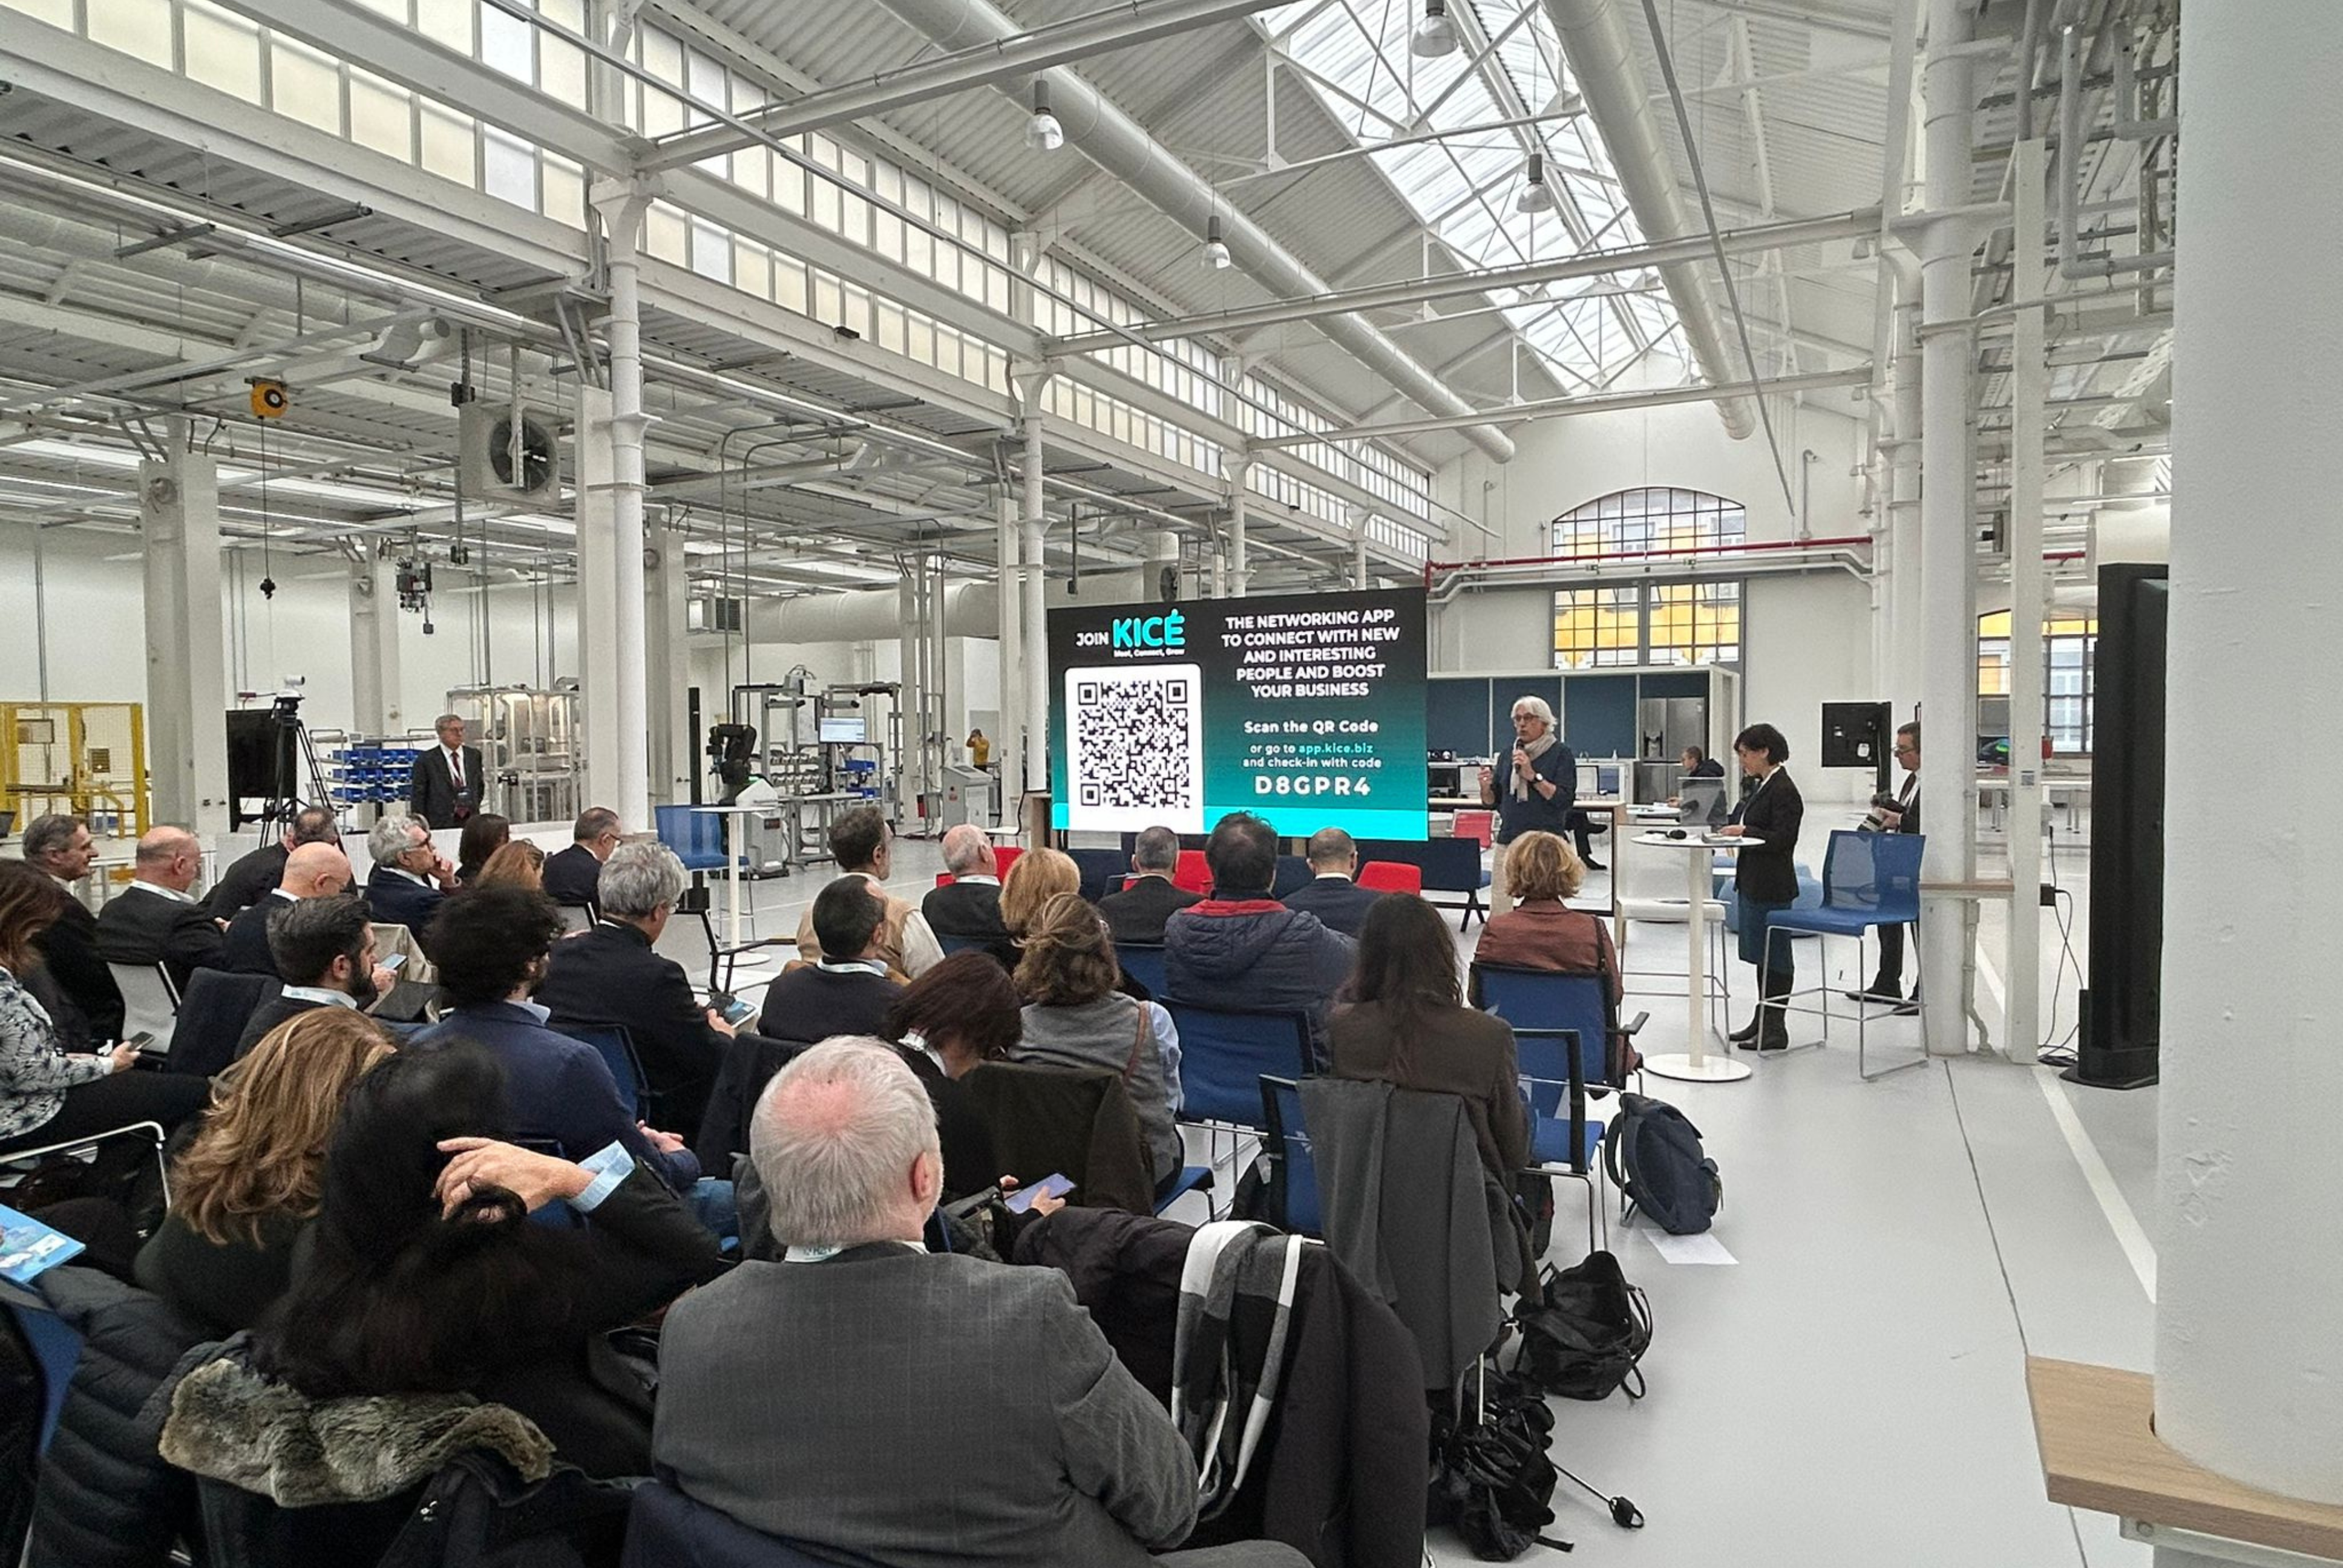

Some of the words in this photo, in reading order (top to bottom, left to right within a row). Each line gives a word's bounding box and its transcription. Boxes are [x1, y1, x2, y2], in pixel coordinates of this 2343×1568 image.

[1225, 616, 1254, 630] THE
[1256, 611, 1359, 628] NETWORKING
[1362, 609, 1395, 624] APP
[1076, 632, 1109, 647] JOIN
[1221, 634, 1241, 647] TO
[1244, 630, 1315, 646] CONNECT
[1317, 629, 1358, 643] WITH
[1362, 627, 1400, 641] NEW
[1244, 650, 1276, 664] AND
[1279, 646, 1376, 662] INTERESTING
[1236, 667, 1293, 681] PEOPLE
[1295, 666, 1329, 680] AND
[1332, 664, 1386, 678] BOOST
[1251, 684, 1292, 697] YOUR
[1295, 682, 1369, 697] BUSINESS
[1244, 720, 1279, 733] Scan
[1283, 720, 1308, 733] the
[1312, 720, 1335, 735] QR
[1339, 720, 1379, 733] Code
[1250, 744, 1262, 754] or
[1265, 744, 1280, 756] go
[1283, 743, 1296, 754] to
[1299, 743, 1373, 755] app.kice.biz
[1243, 757, 1264, 768] and
[1268, 757, 1318, 768] check-in
[1321, 757, 1348, 768] with
[1352, 757, 1382, 768] code
[1255, 775, 1371, 796] D8GPR4
